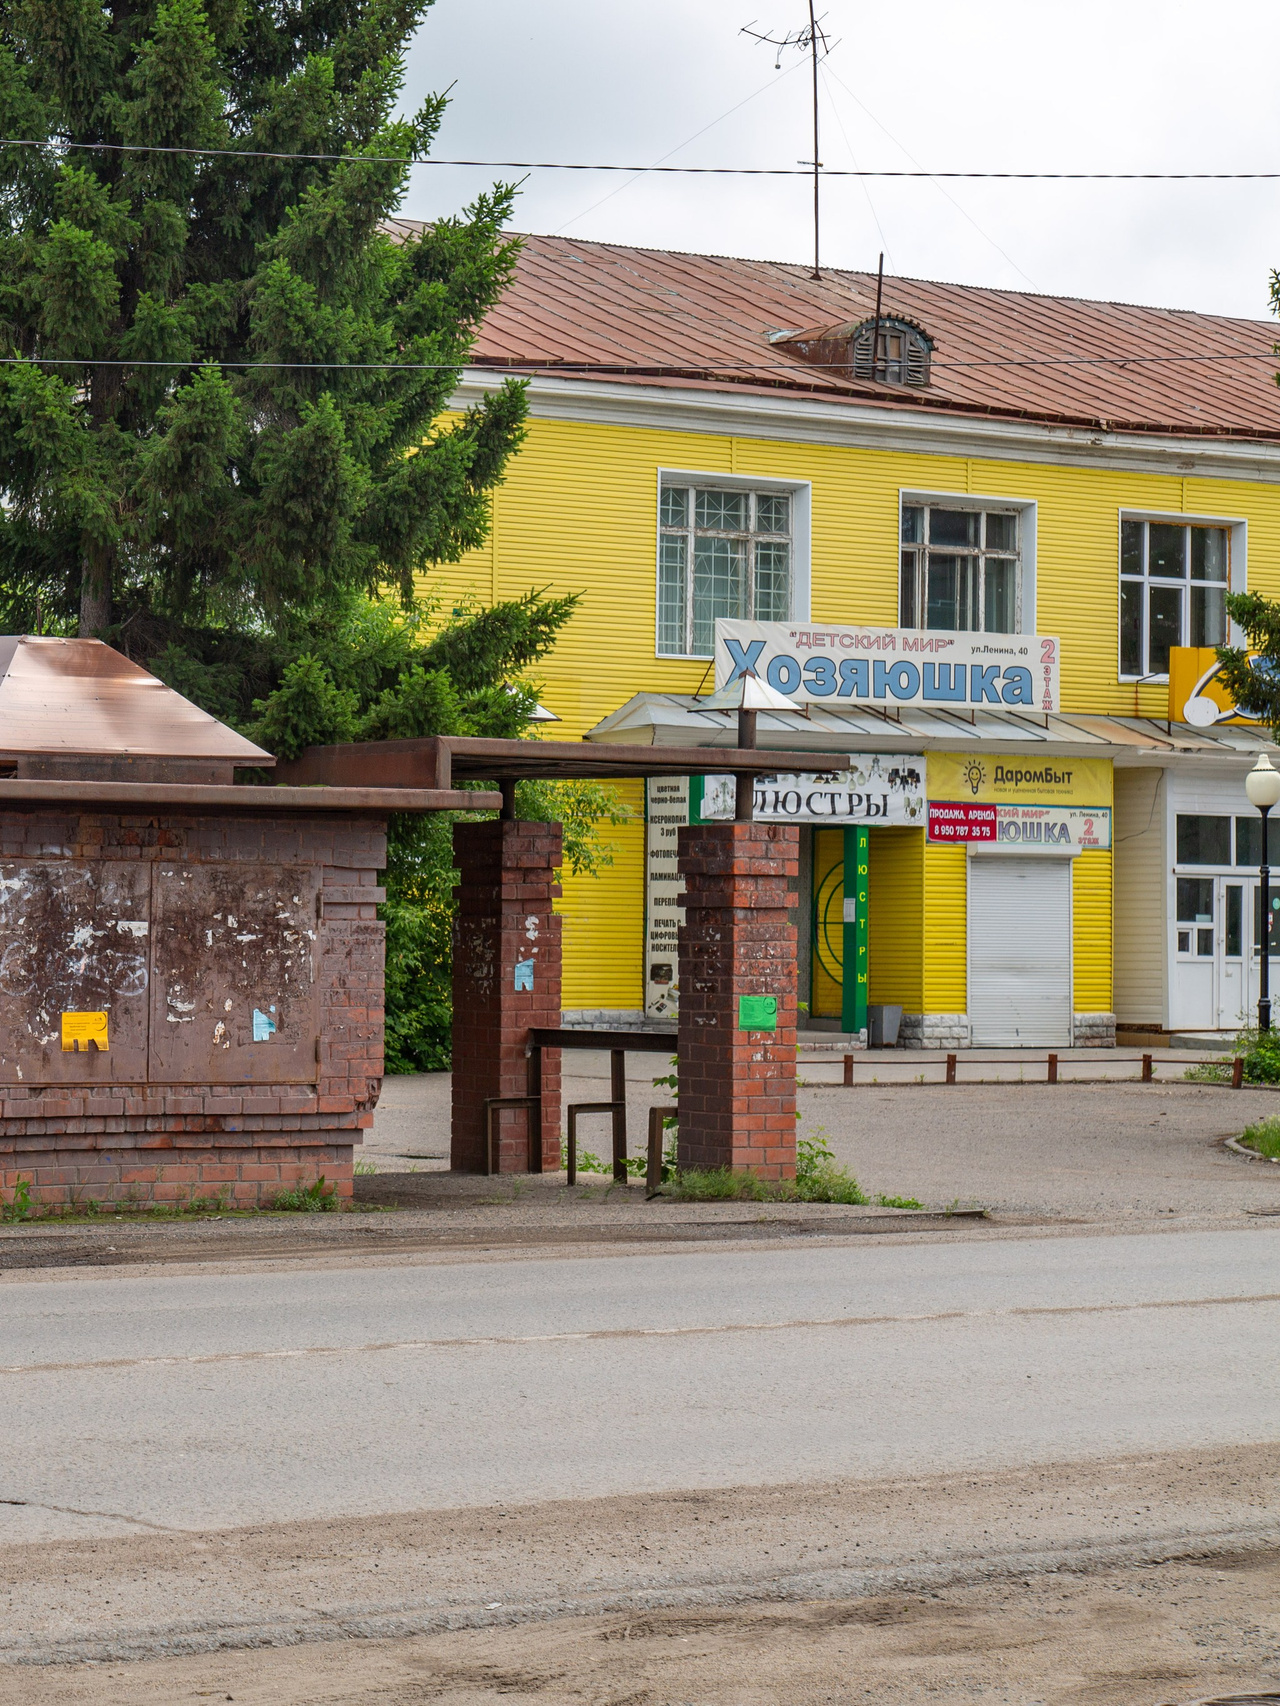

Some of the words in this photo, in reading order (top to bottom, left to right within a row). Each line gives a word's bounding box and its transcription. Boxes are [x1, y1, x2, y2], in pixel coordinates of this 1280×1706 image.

[1018, 647, 1028, 656] 40
[1040, 638, 1056, 664] 2
[723, 638, 1034, 705] Хозяюшка
[994, 765, 1073, 787] ДаромБыт
[752, 790, 889, 817] ЛЮСТРЫ
[968, 810, 995, 820] АРЕНДА
[934, 825, 940, 835] 8
[941, 825, 954, 836] 950
[956, 826, 969, 836] 787
[972, 826, 981, 837] 35
[982, 827, 991, 837] 75
[998, 821, 1071, 843] ЮШКА
[1083, 818, 1094, 836] 2
[650, 872, 685, 882] ЛАМИНАЦИ
[654, 897, 678, 906] ПЕРЕПЛ
[857, 837, 868, 984] ЛЮСТРЫ
[651, 943, 678, 952] НОСИТЕЛ
